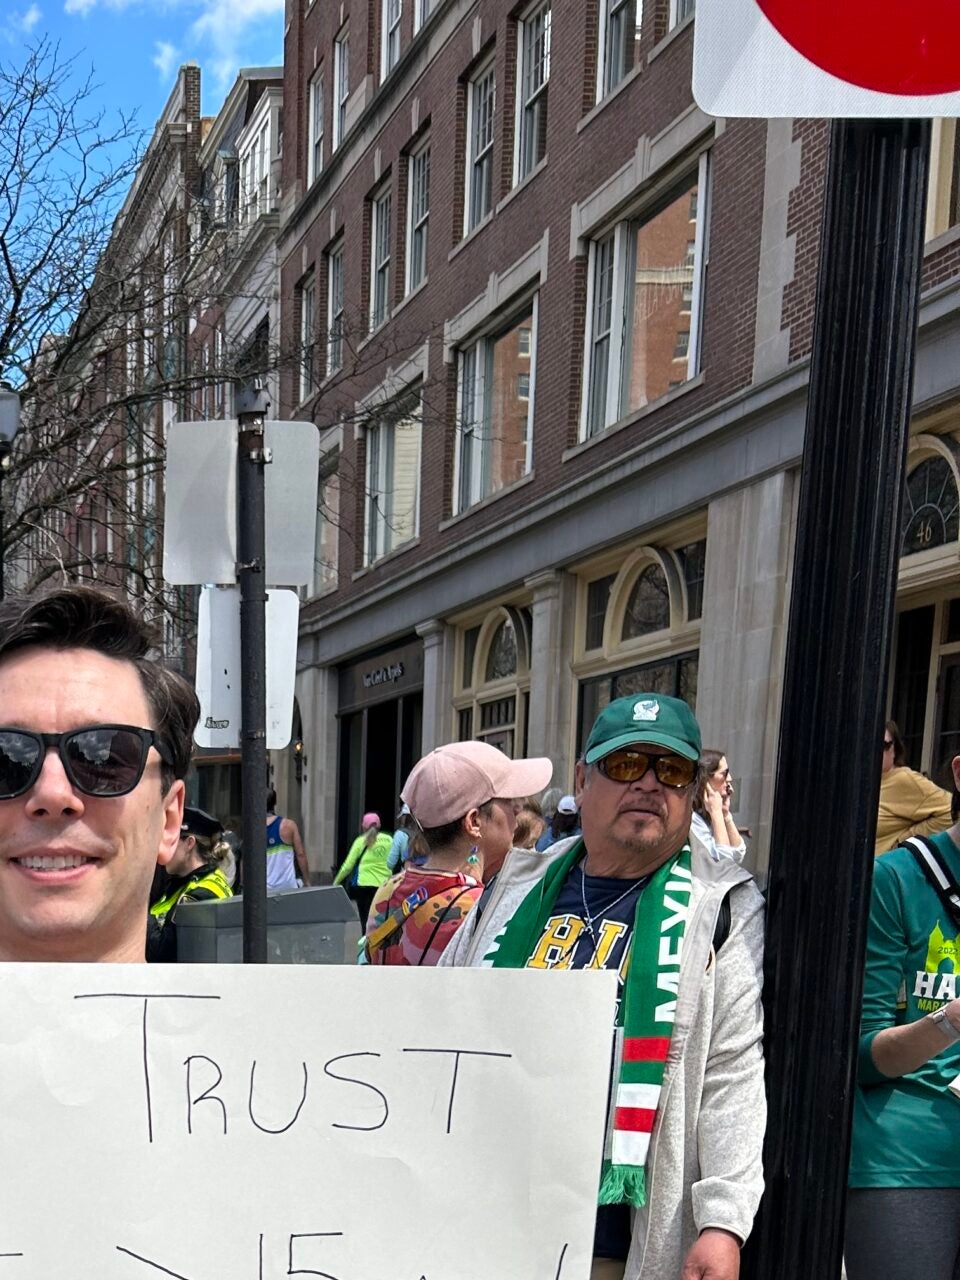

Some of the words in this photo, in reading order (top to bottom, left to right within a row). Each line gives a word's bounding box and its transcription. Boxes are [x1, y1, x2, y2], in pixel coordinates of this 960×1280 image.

[525, 914, 633, 985] HI
[937, 946, 958, 955] 2022
[73, 992, 513, 1144] TRUST
